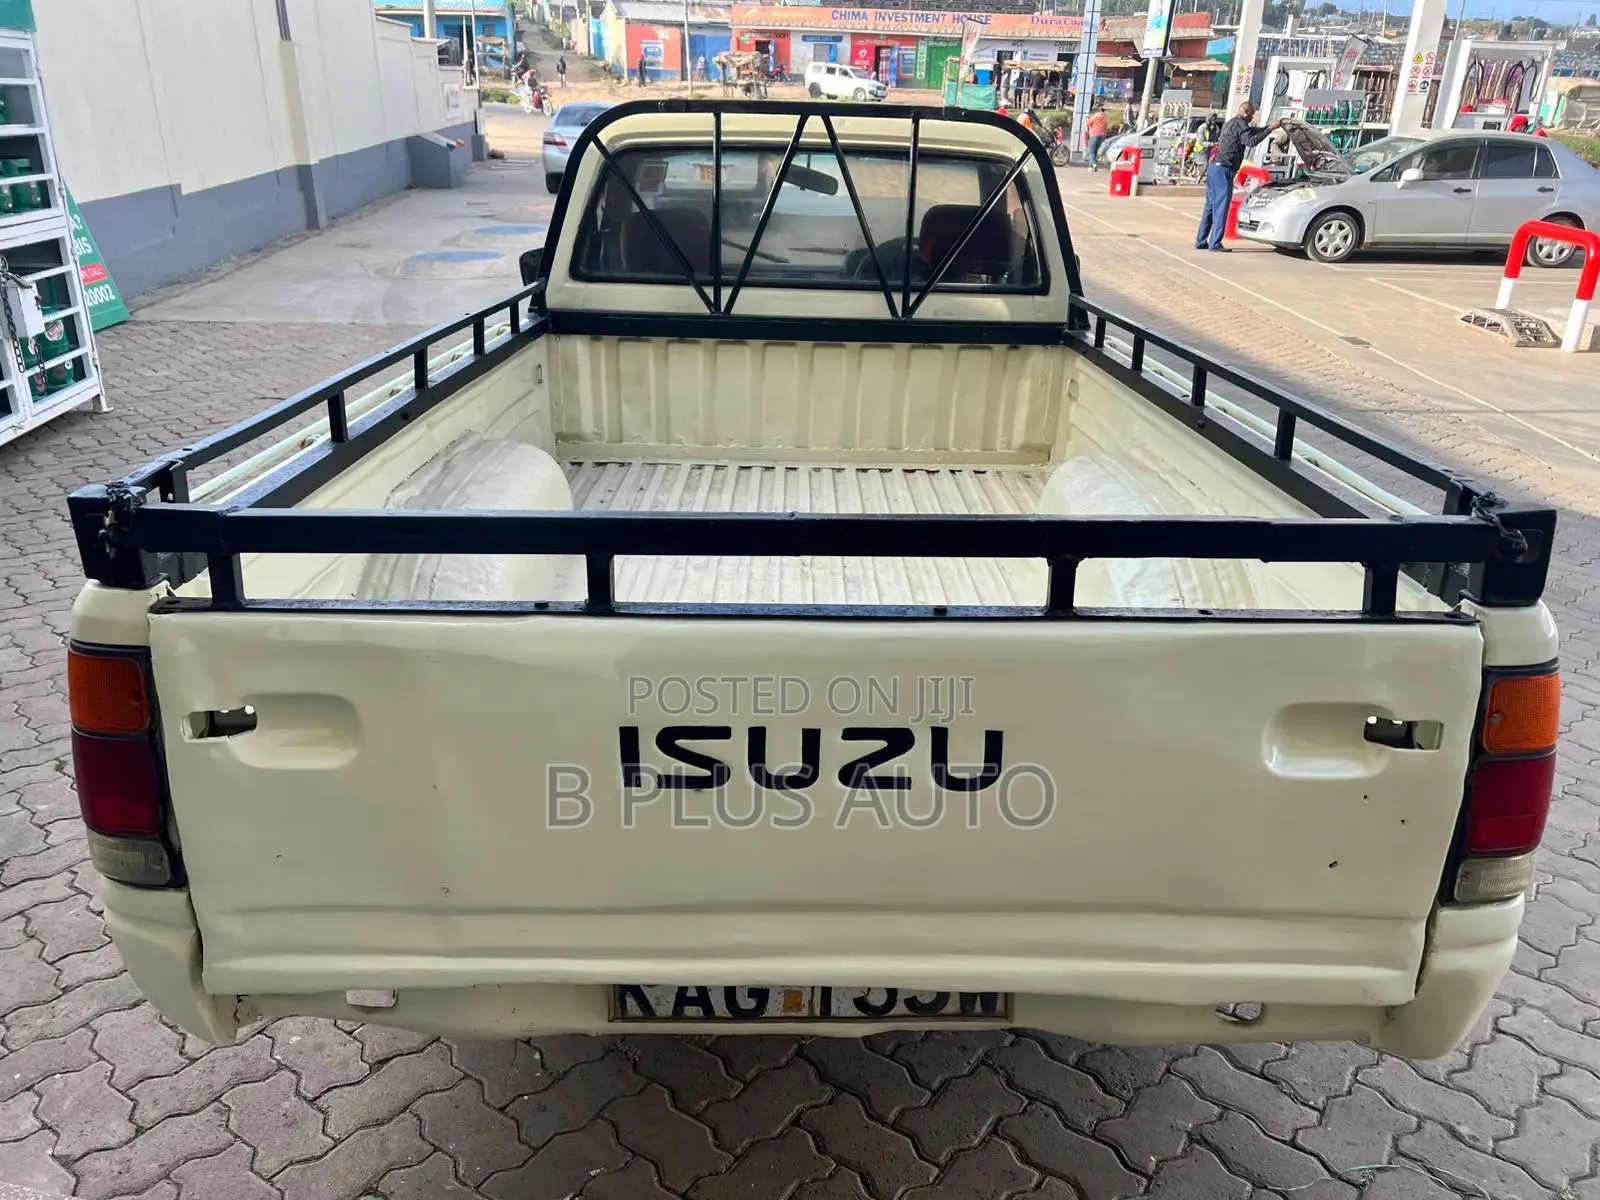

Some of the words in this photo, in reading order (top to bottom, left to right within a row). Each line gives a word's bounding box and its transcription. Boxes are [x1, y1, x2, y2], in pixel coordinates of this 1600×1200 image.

[832, 10, 868, 21] CHIMA
[874, 11, 947, 23] INVESTMENT
[619, 725, 1004, 791] ISUZU
